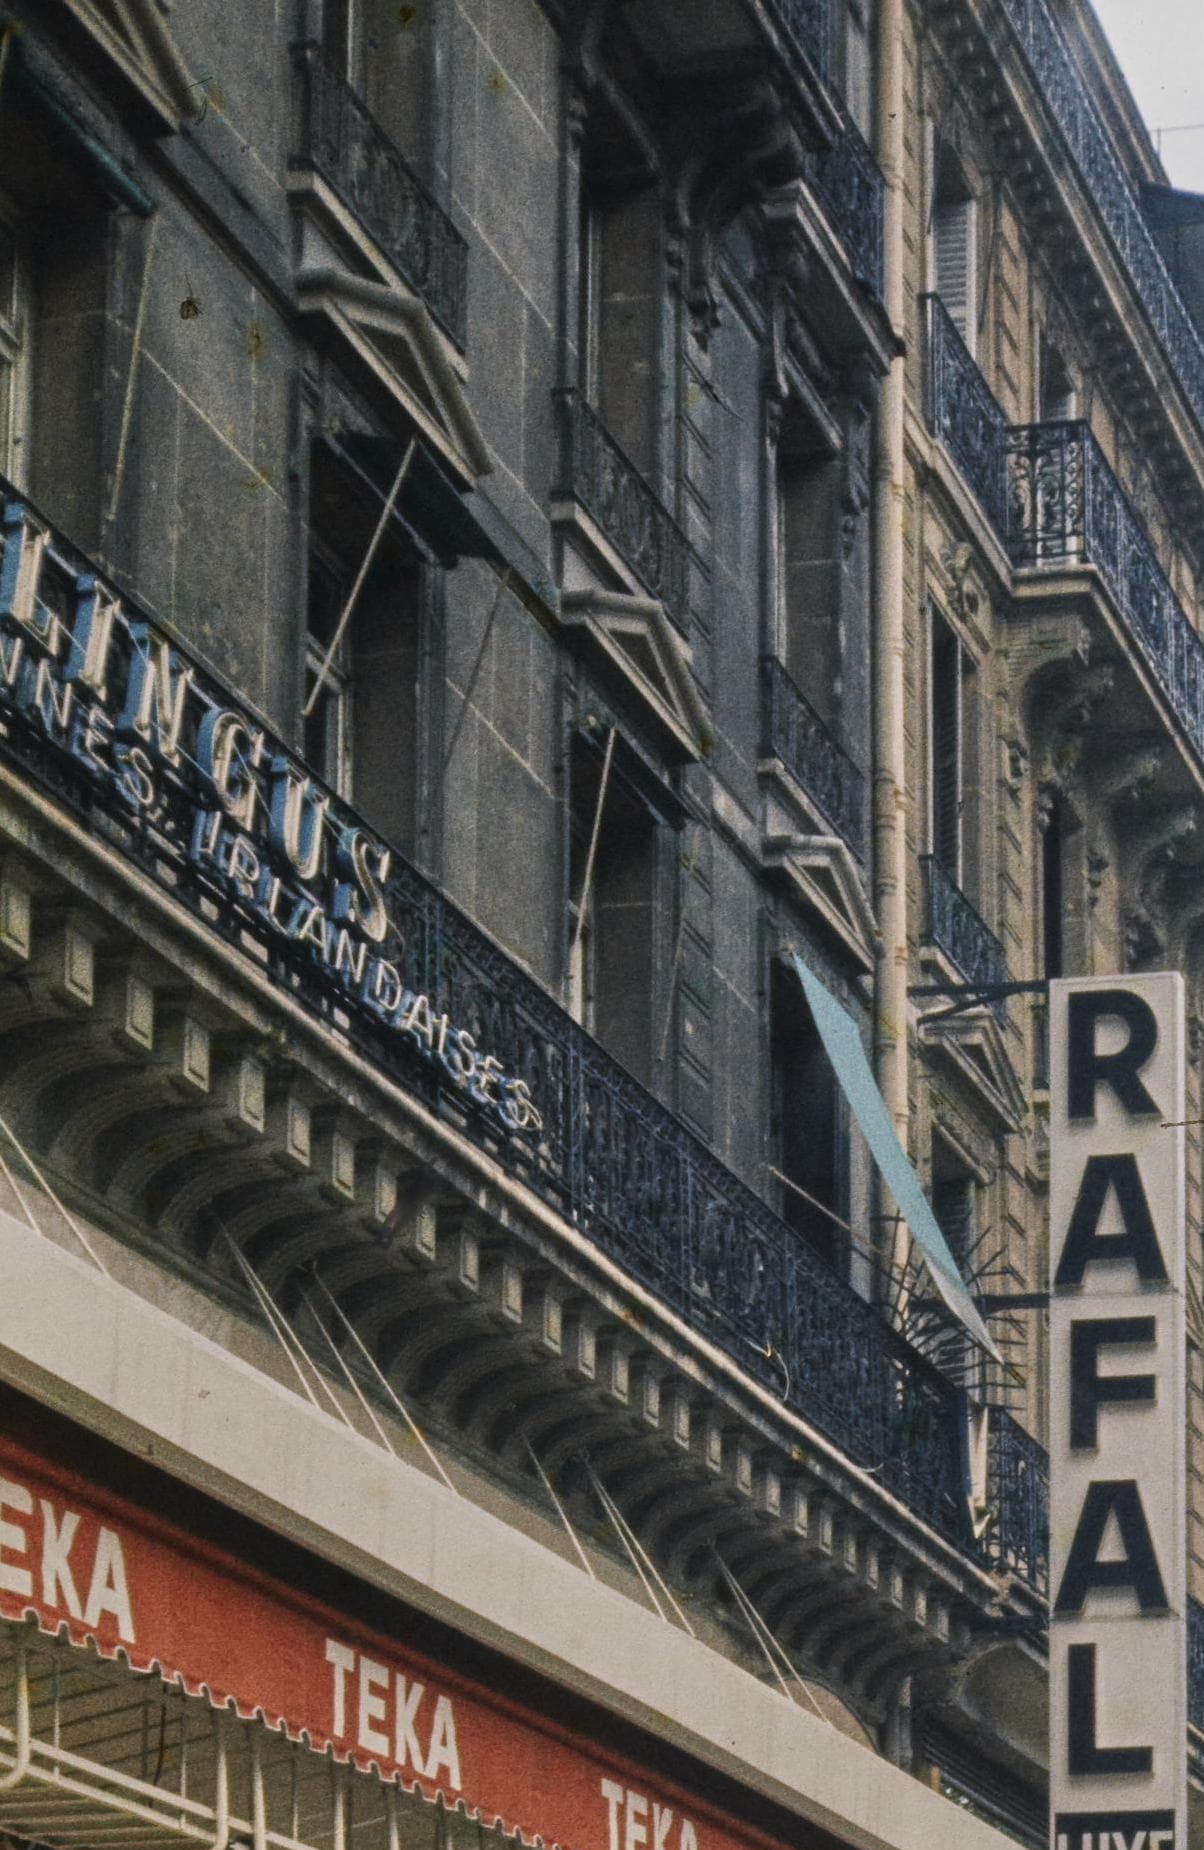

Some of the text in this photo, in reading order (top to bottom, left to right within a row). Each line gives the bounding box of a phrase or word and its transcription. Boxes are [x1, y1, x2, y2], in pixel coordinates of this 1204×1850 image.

[4, 510, 391, 943] LINGUS
[198, 808, 544, 1131] IRLANDAISES
[1054, 988, 1169, 1776] RAFAL
[0, 1479, 136, 1644] EKA
[325, 1637, 463, 1792] TEKA
